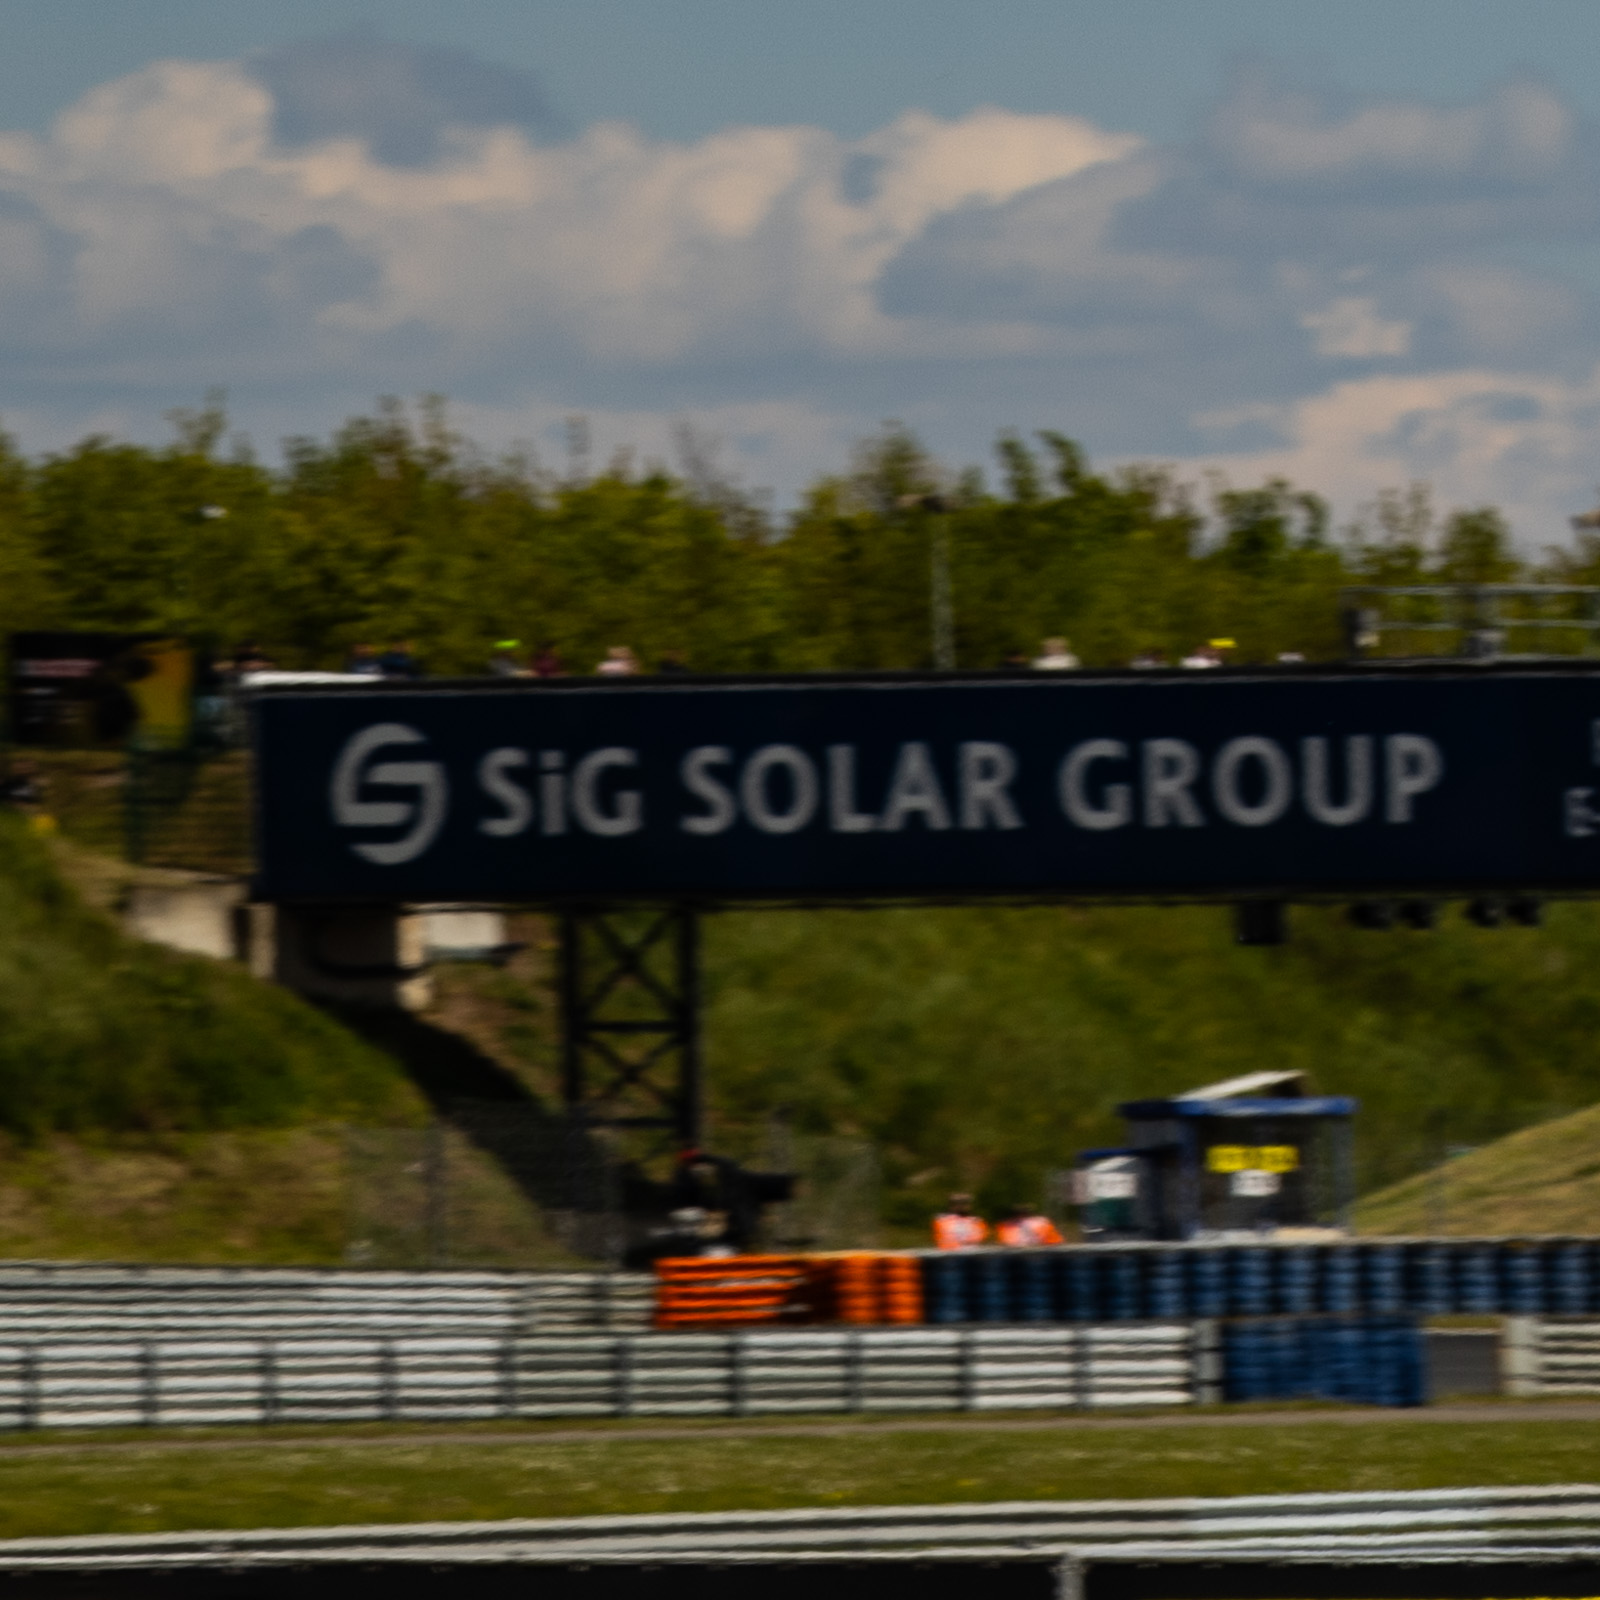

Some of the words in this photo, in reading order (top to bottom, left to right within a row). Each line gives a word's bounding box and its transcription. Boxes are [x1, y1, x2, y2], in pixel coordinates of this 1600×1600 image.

[477, 745, 644, 838] SiG
[681, 741, 1025, 835] SOLAR
[1059, 733, 1443, 831] GROUP
